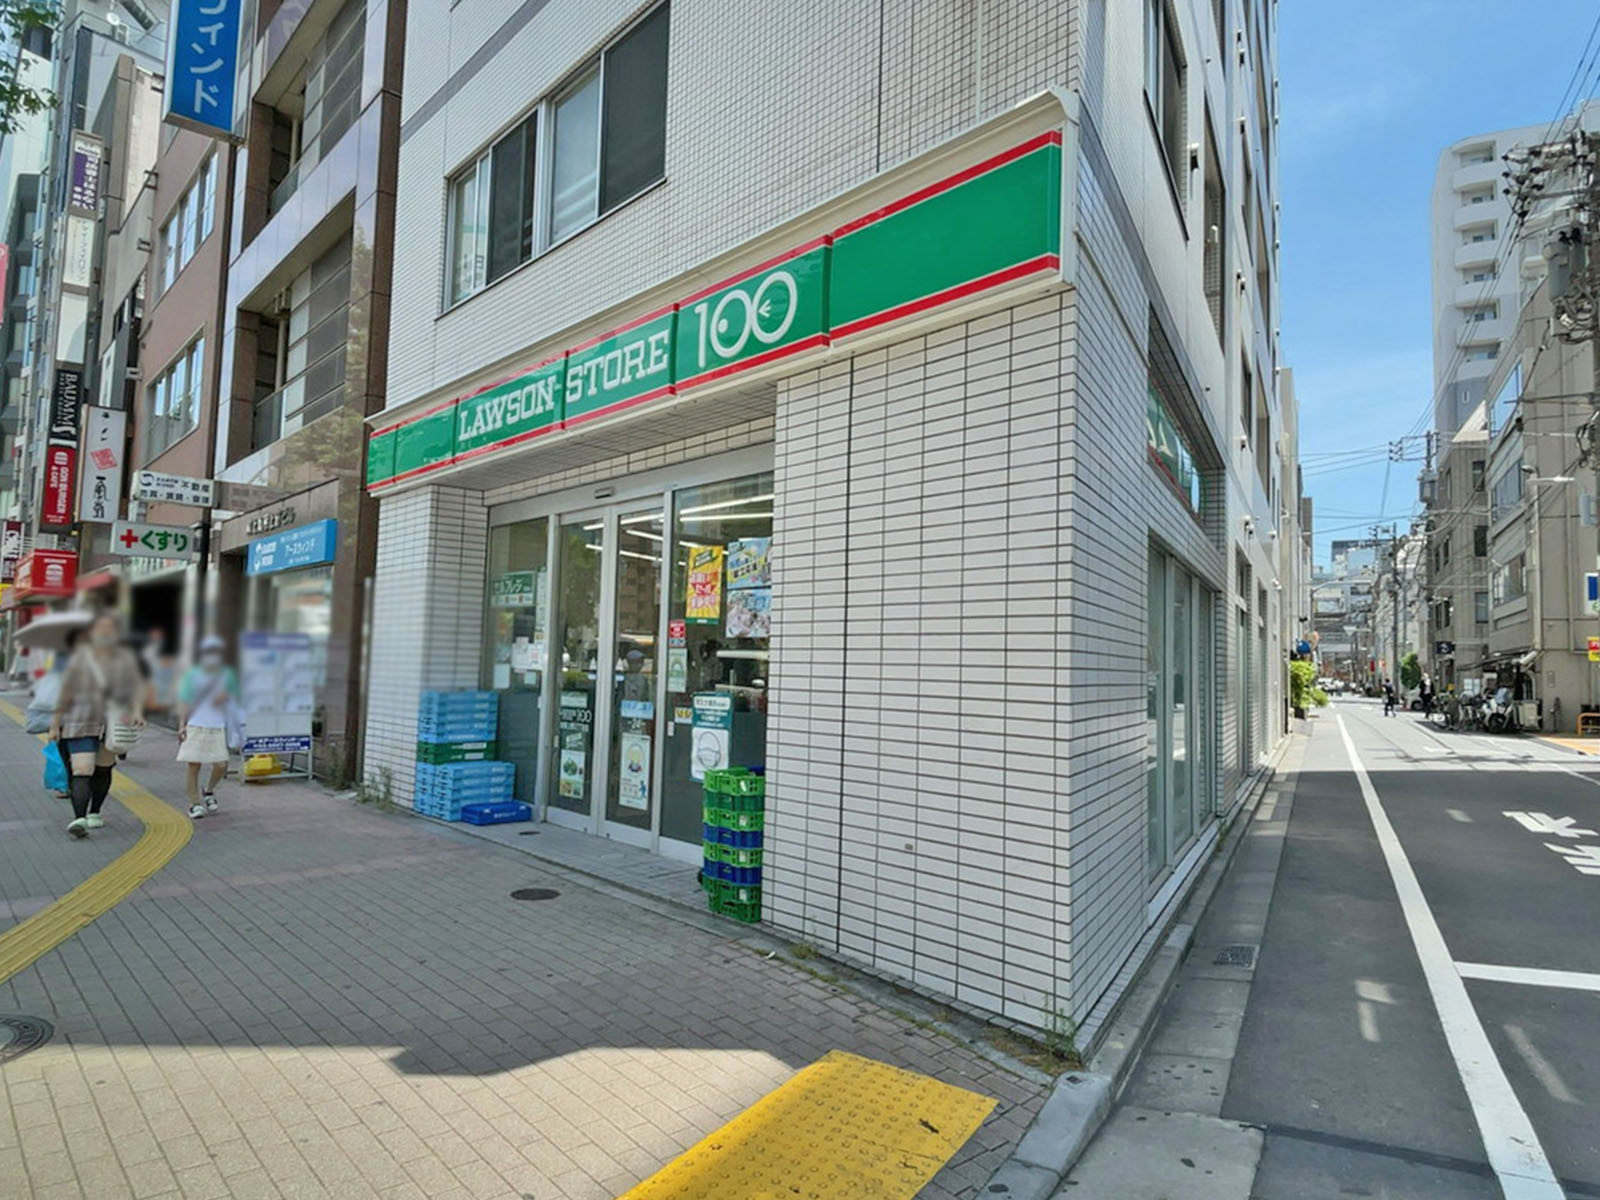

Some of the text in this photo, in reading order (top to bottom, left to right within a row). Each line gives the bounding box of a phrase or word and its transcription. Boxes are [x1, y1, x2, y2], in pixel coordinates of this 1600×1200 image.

[458, 271, 798, 441] LAWSON STORE 100
[141, 530, 188, 552] くすり
